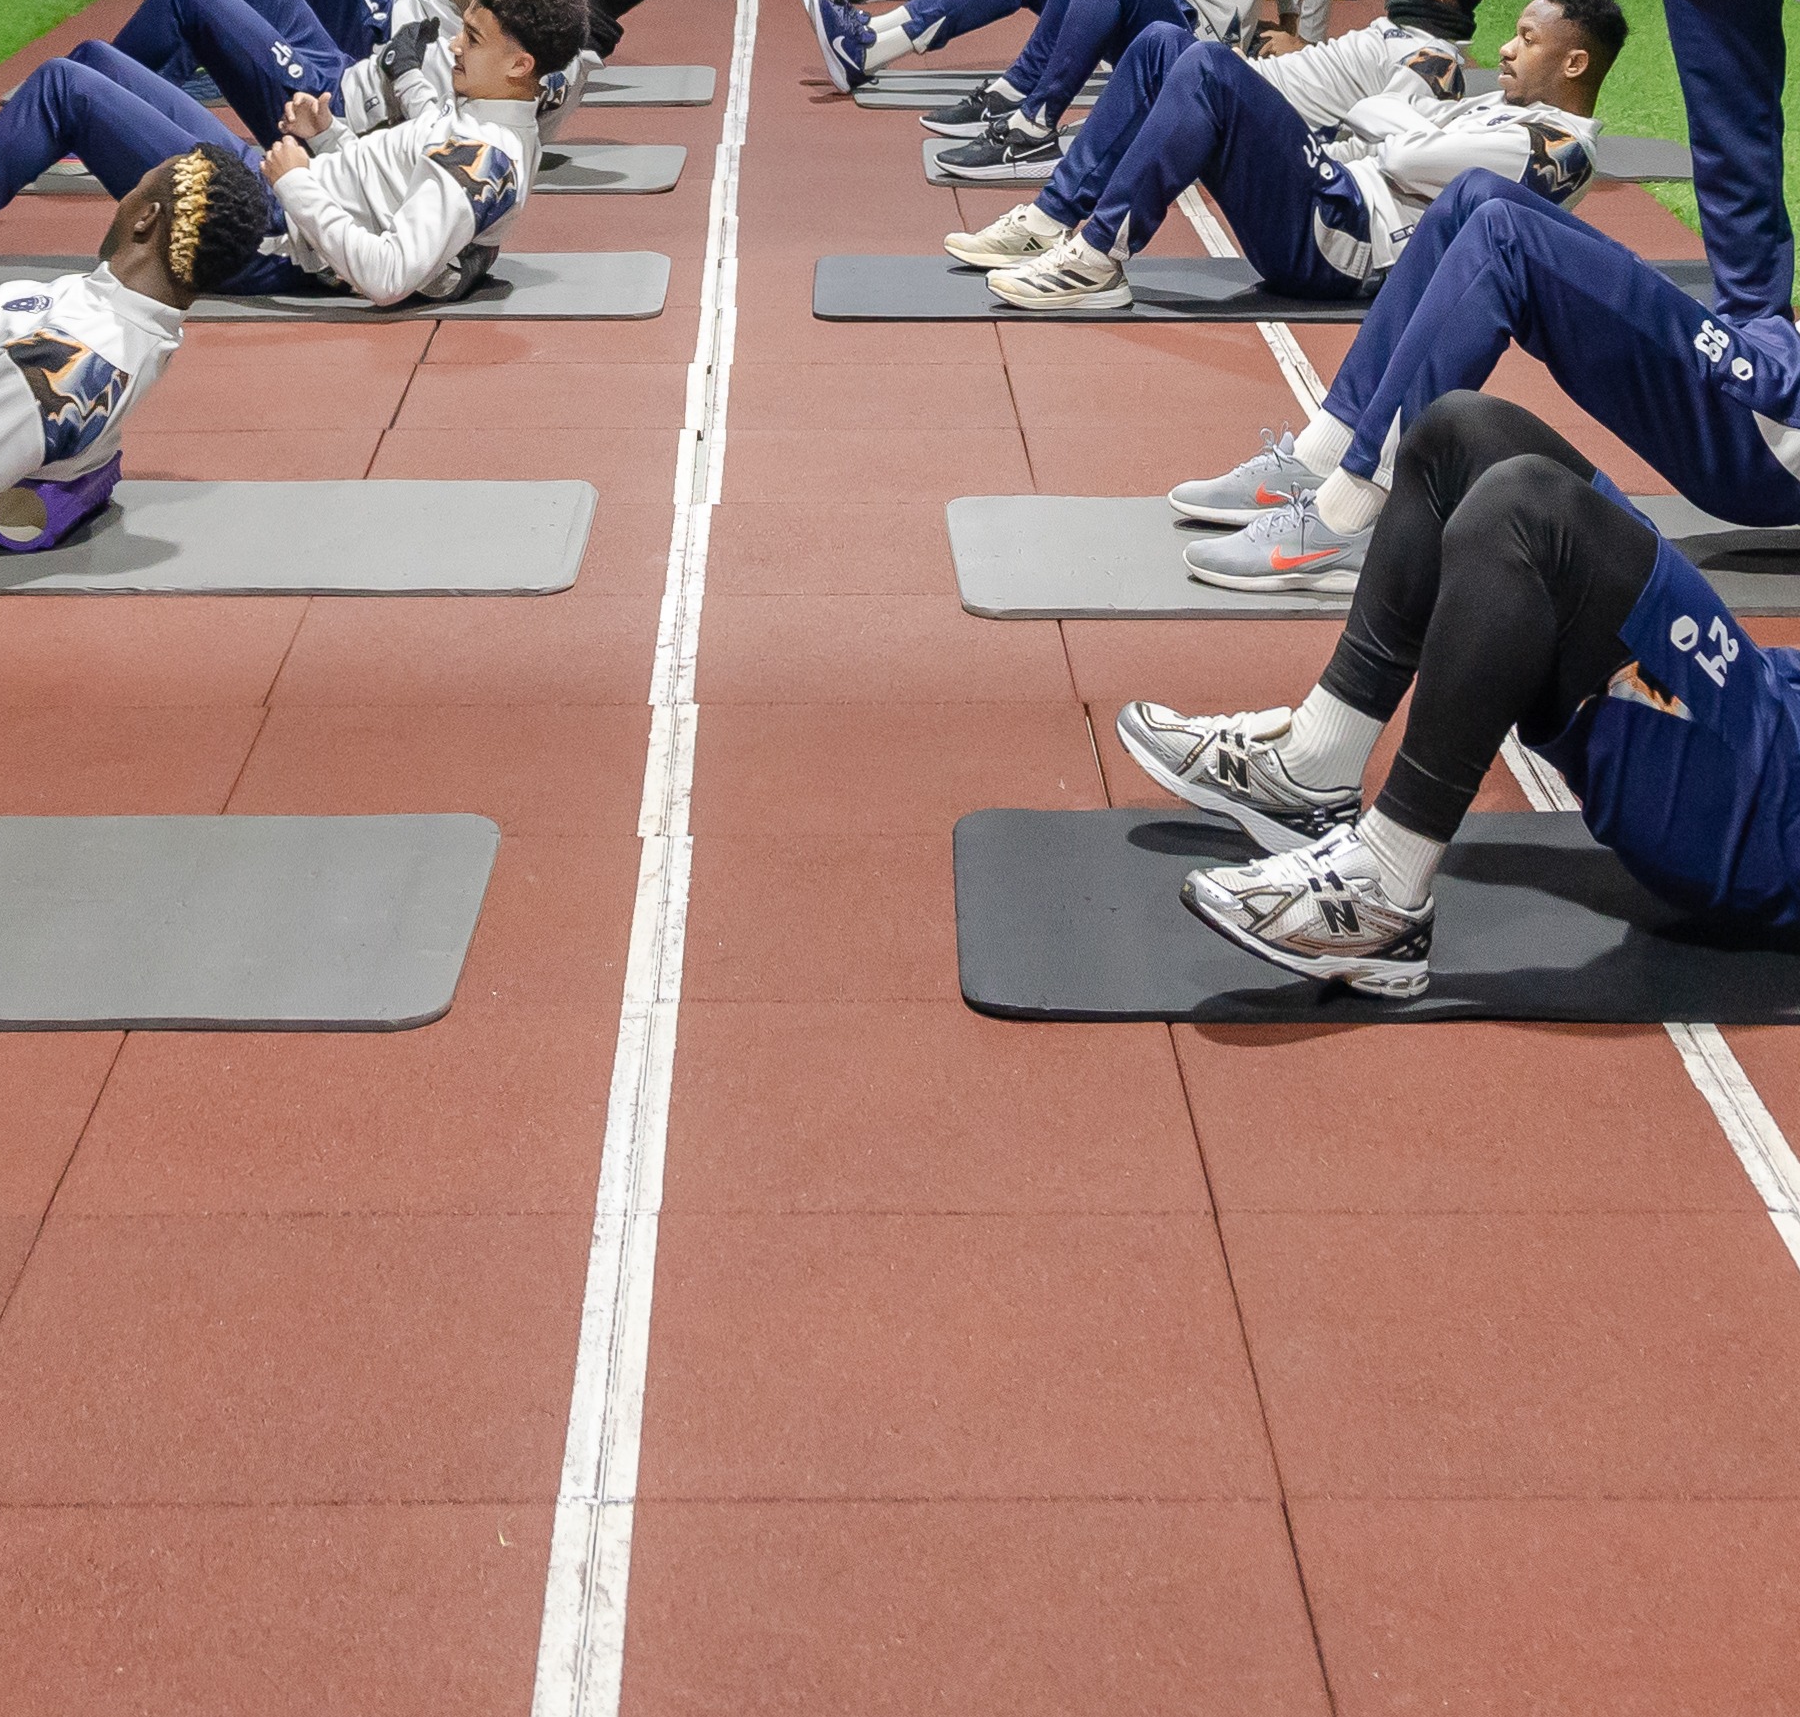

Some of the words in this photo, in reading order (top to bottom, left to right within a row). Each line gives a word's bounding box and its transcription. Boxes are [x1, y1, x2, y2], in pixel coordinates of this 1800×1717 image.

[1693, 615, 1740, 688] 24
[1217, 746, 1252, 793] N
[1316, 897, 1363, 938] N
